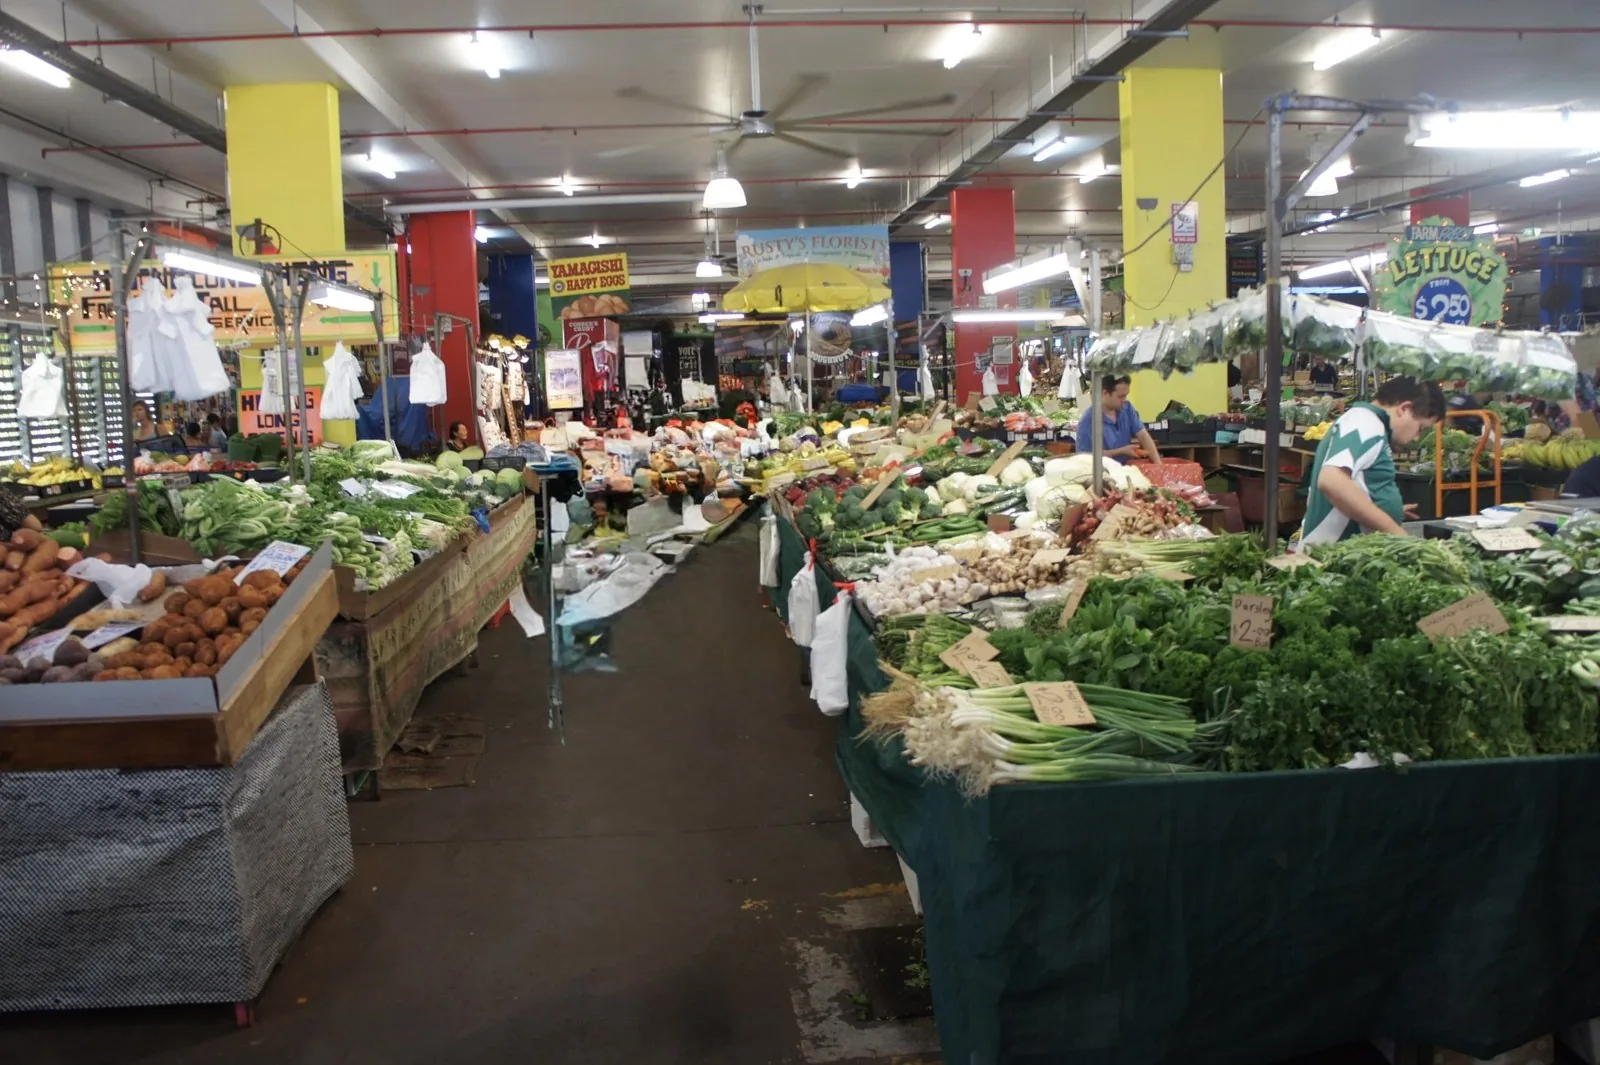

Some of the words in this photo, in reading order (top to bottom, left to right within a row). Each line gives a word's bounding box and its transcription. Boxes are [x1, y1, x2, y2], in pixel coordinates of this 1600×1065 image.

[1411, 225, 1439, 240] FARM
[740, 235, 806, 258] RUSTY'S
[550, 258, 624, 279] YAMAGISHI
[1389, 245, 1499, 286] LETTUCE
[566, 277, 598, 292] HAPPY
[600, 274, 626, 288] EGGS
[257, 412, 300, 428] LONG
